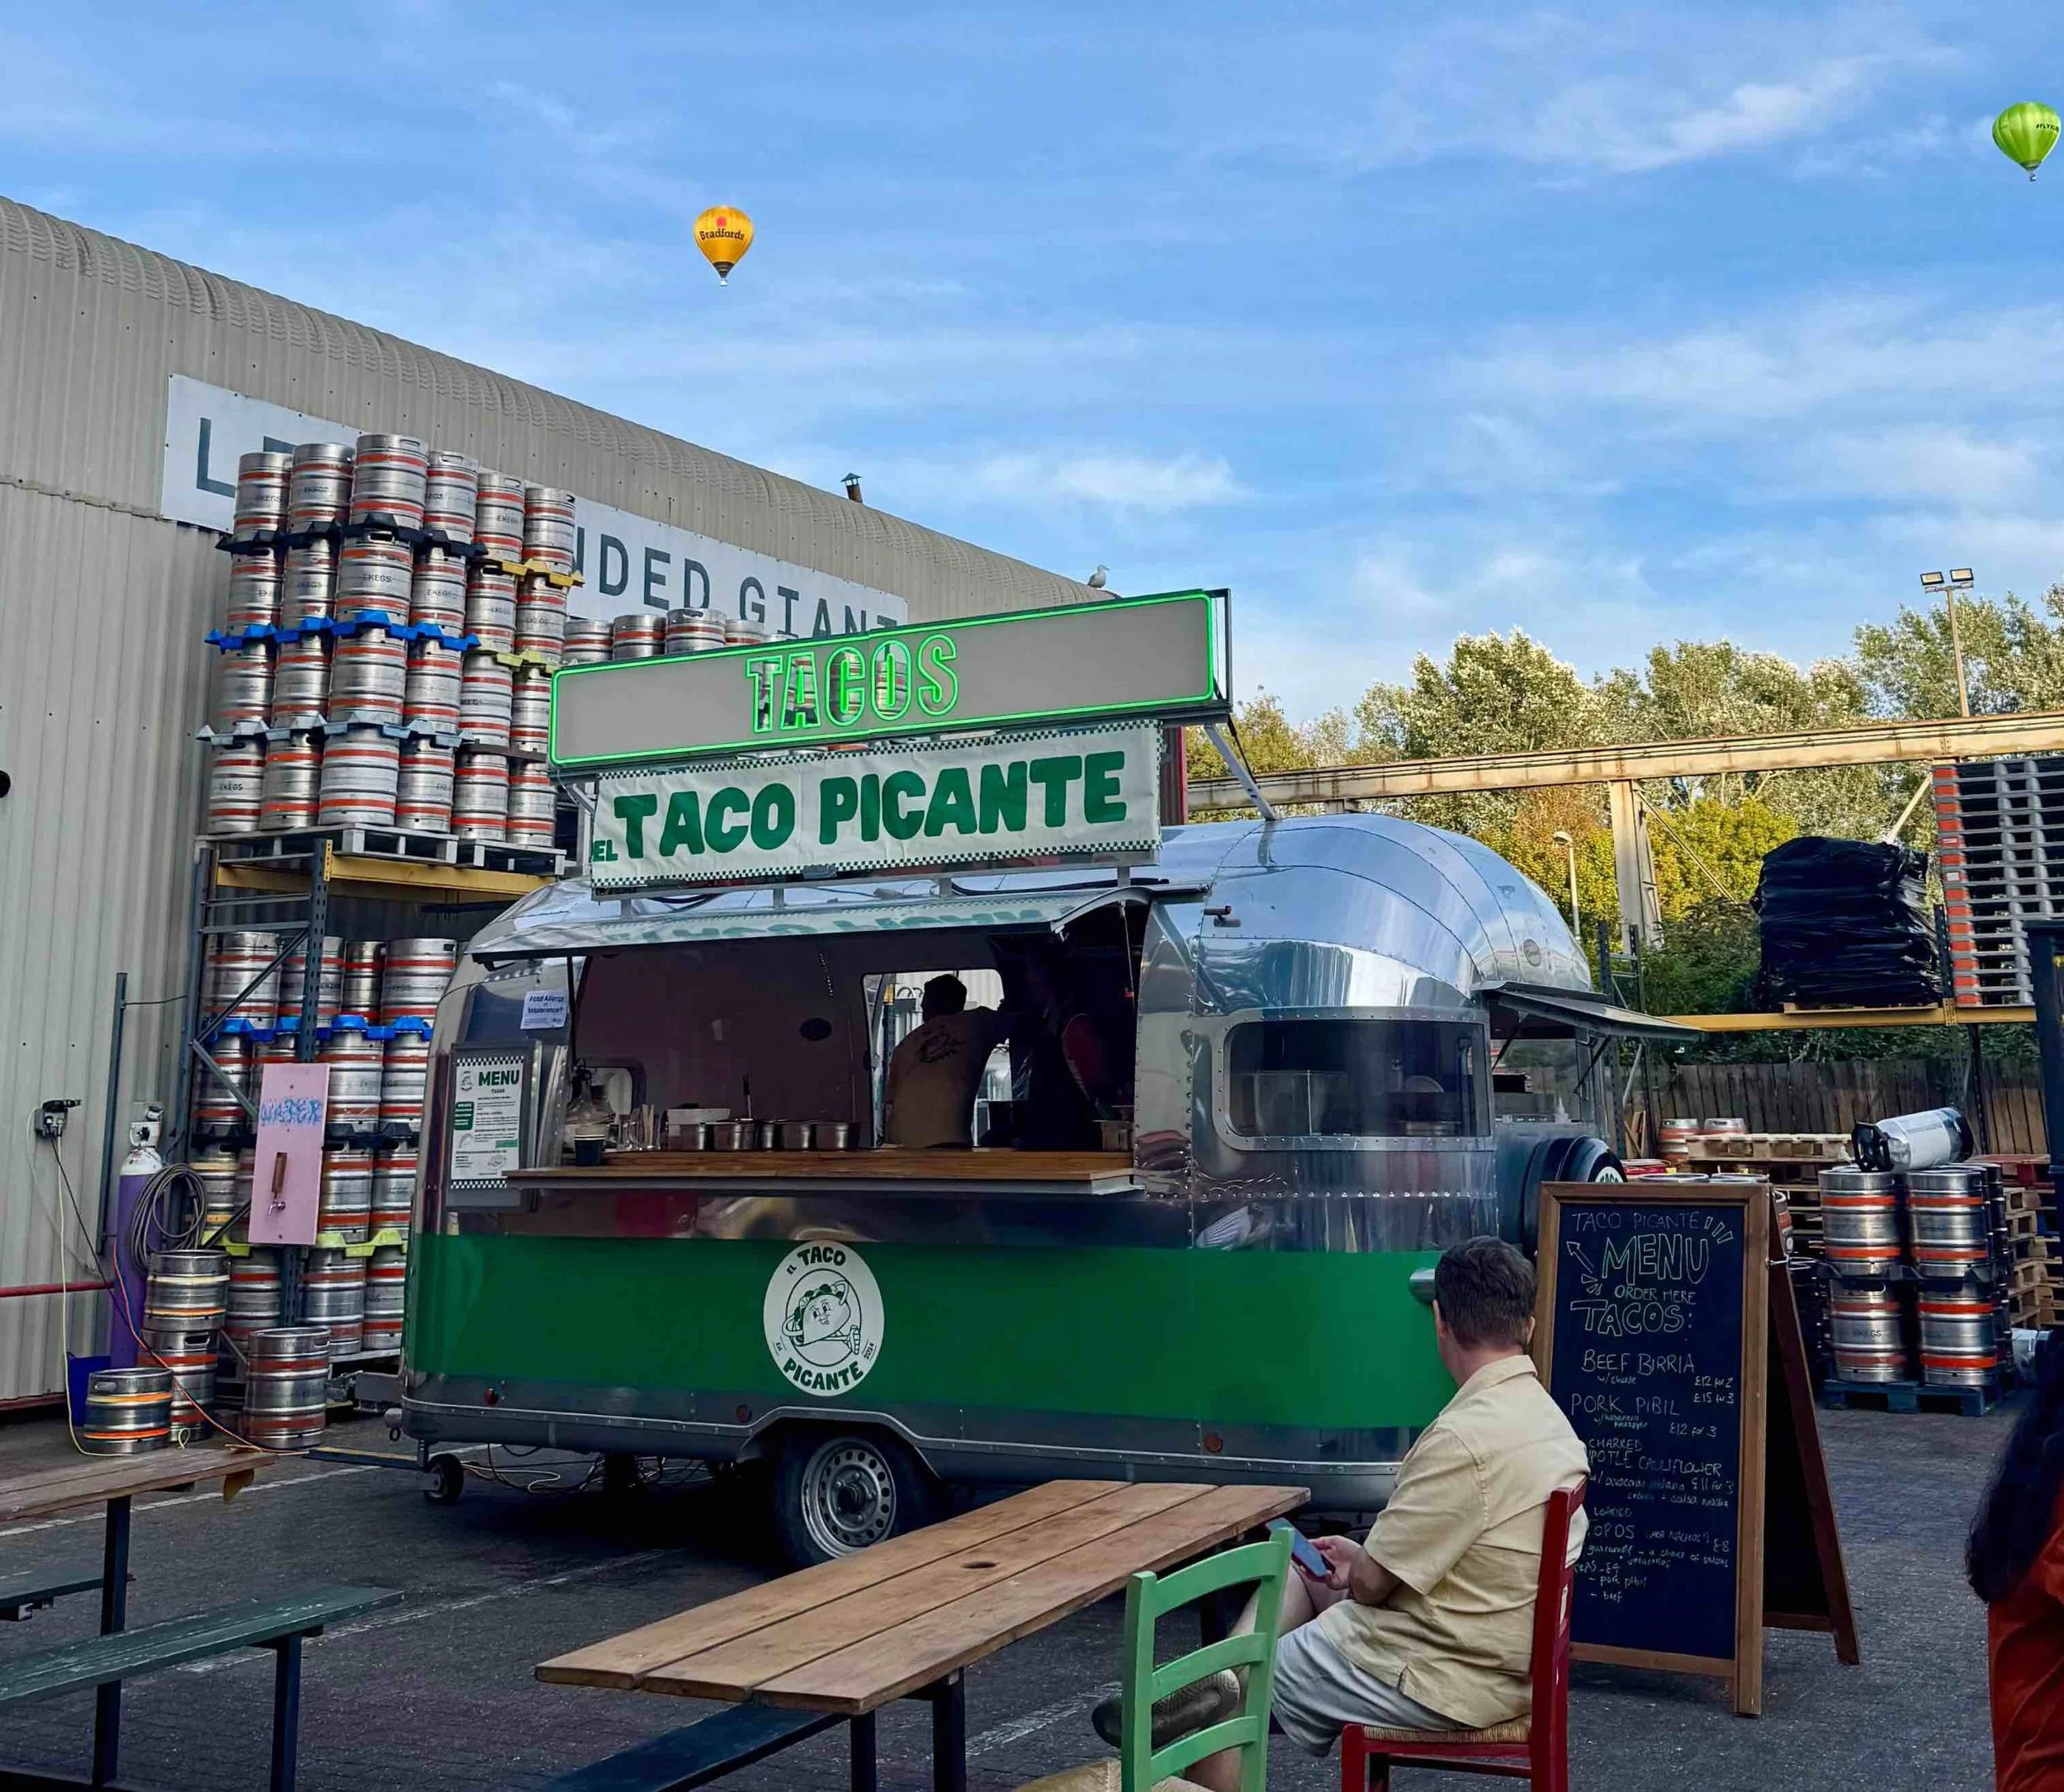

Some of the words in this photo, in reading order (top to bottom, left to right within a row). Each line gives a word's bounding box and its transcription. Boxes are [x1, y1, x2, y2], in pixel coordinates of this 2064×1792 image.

[699, 229, 745, 240] Bradfords
[362, 573, 393, 583] EKEGS
[746, 634, 958, 733] TACOS
[592, 839, 618, 862] EL
[614, 783, 796, 858] TACO
[818, 750, 1128, 844] PICANTE
[478, 1070, 520, 1086] MENU
[1571, 1212, 1622, 1232] TACO
[1633, 1211, 1701, 1230] PICANTE
[798, 1246, 846, 1266] TACO
[1601, 1232, 1710, 1286] MENU
[1614, 1284, 1658, 1301] ORDER
[1663, 1288, 1697, 1306] HERE
[1581, 1349, 1631, 1374] BEEF
[1636, 1352, 1695, 1376] BIRRIA
[783, 1358, 864, 1390] PICANTE
[1570, 1392, 1623, 1416] PORK
[1636, 1396, 1681, 1416] PIBIL
[1727, 1392, 1735, 1404] 3
[1706, 1425, 1718, 1438] 3
[1588, 1438, 1643, 1452] CHARRED
